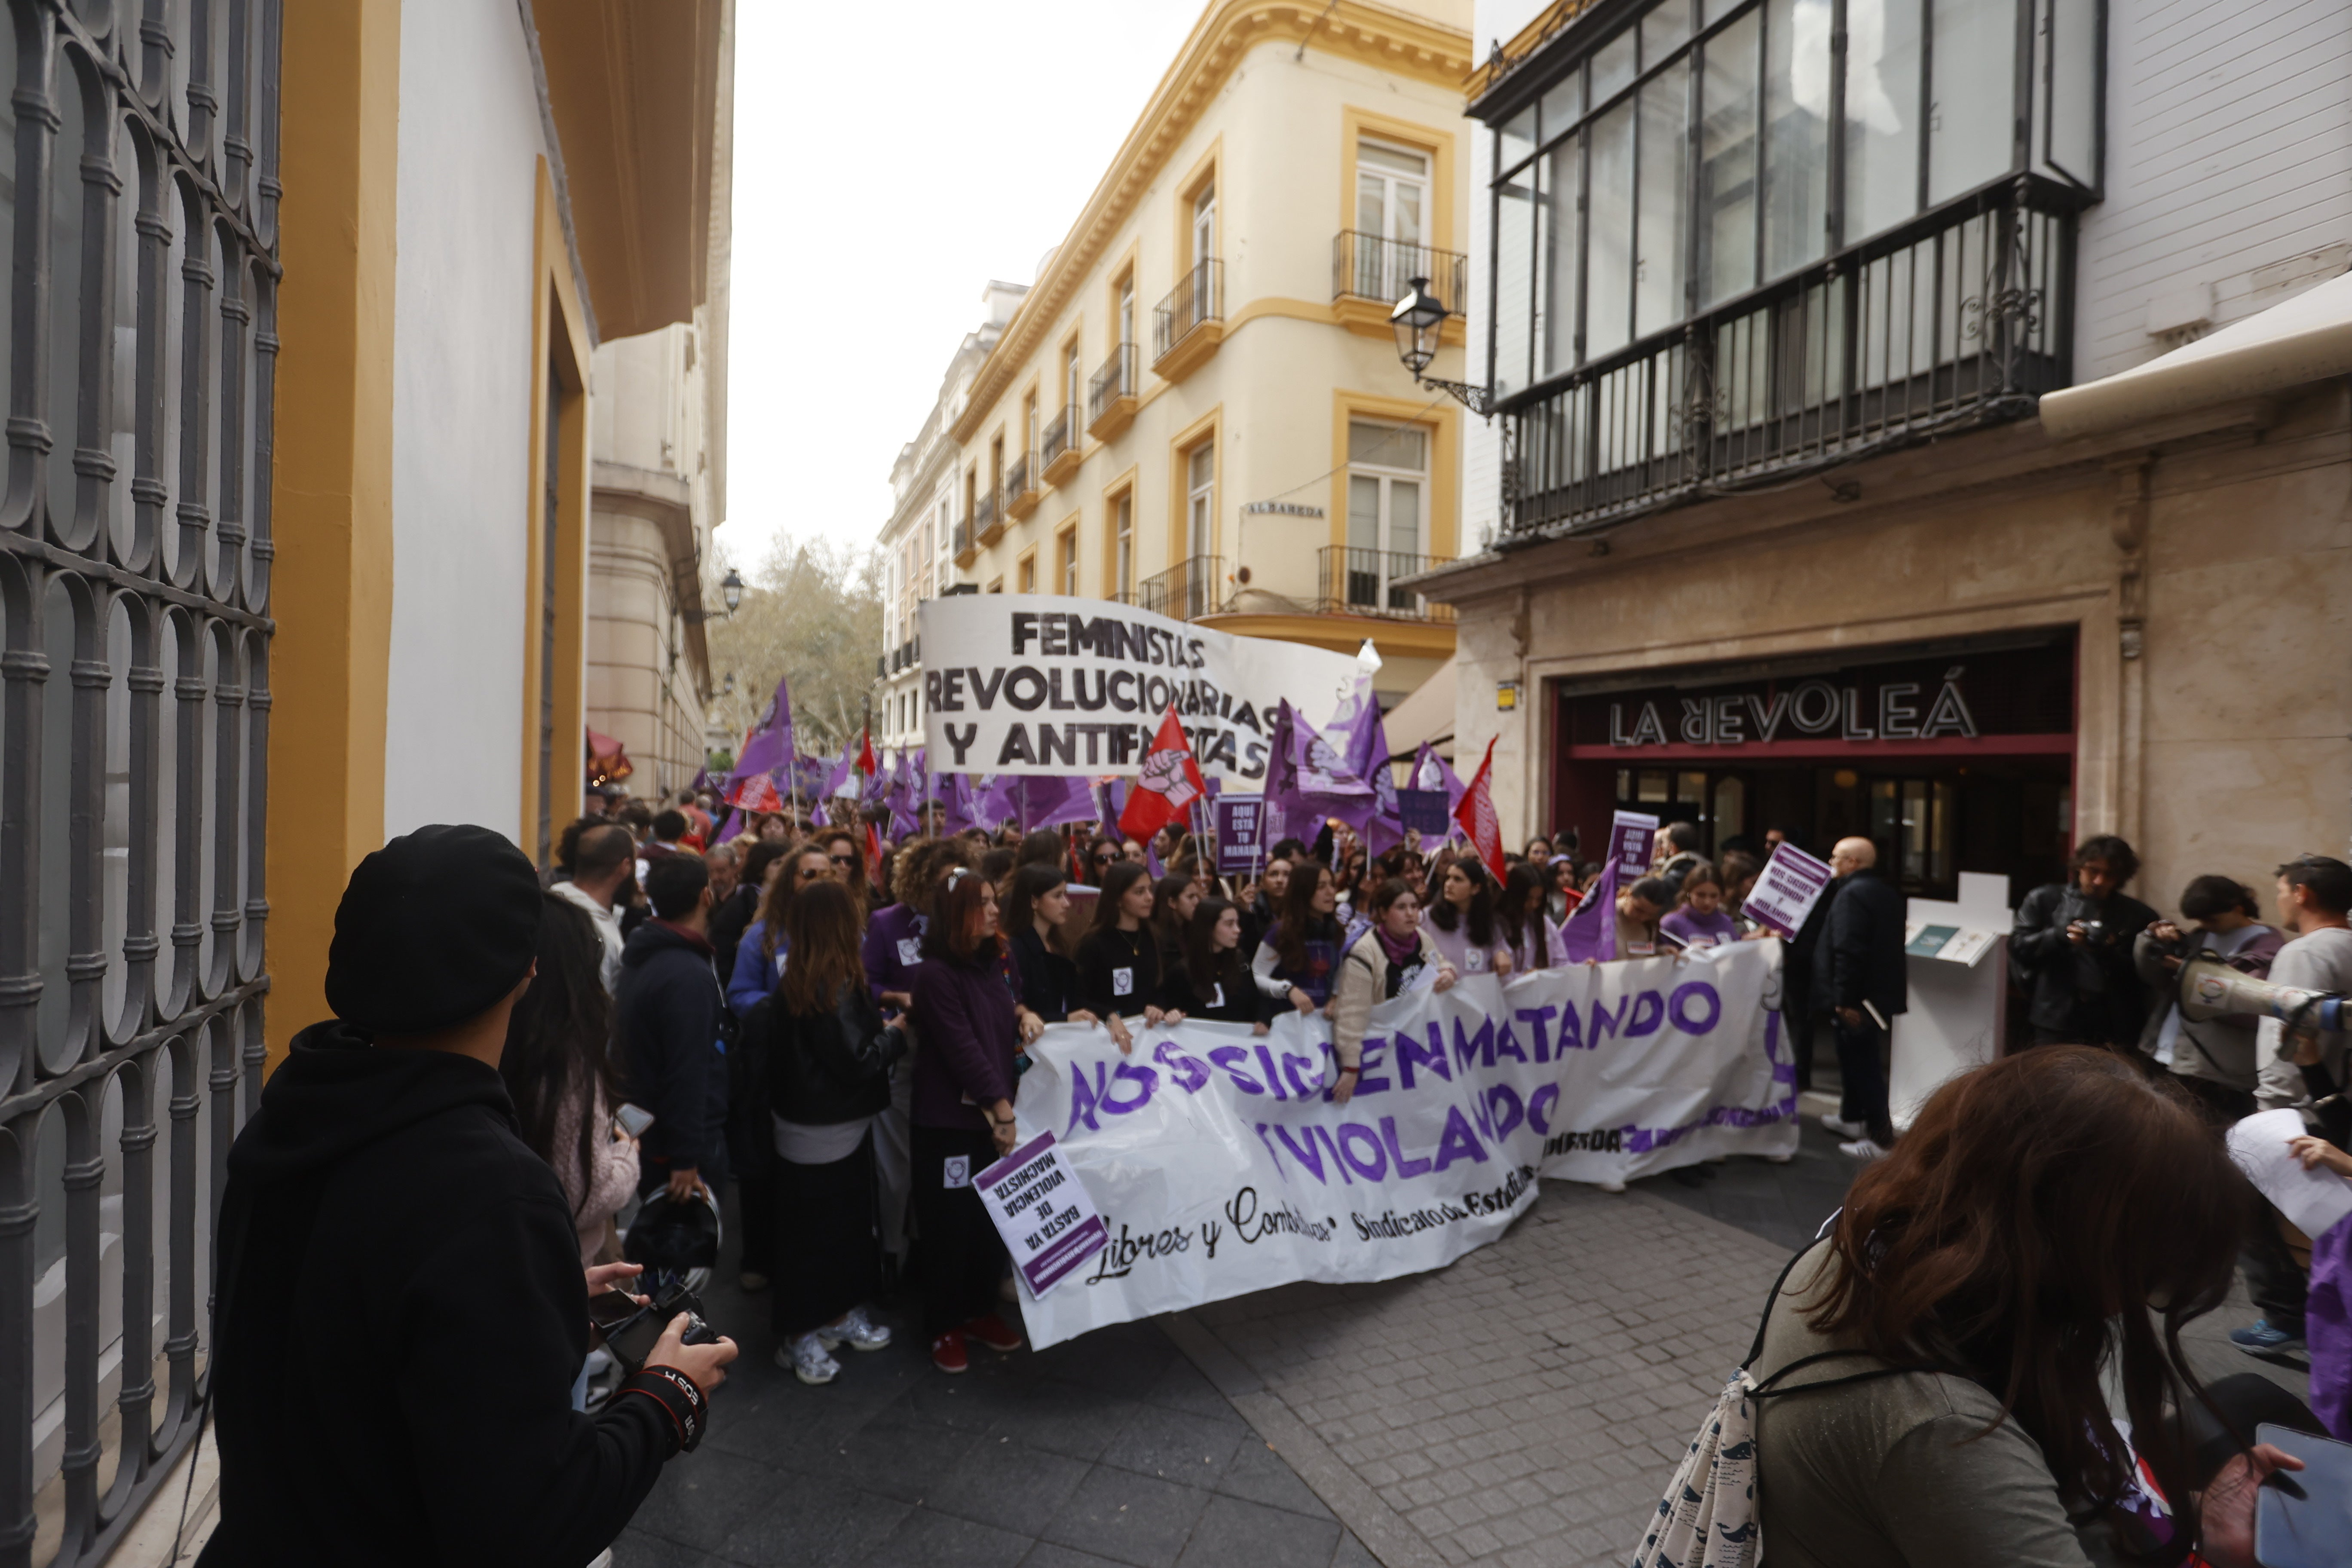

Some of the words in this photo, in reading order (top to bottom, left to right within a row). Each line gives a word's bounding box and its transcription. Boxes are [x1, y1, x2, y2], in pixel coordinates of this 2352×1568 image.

[1248, 503, 1323, 517] ALBAREDA
[1011, 612, 1204, 669] FEMINISTAS
[944, 723, 977, 765] Y
[1609, 702, 1667, 747] LA
[1237, 832, 1250, 843] TU
[1065, 1040, 1211, 1140] NOS
[1454, 980, 1721, 1075] MATANDO
[993, 1152, 1057, 1200] MACHISTA
[1003, 1169, 1066, 1219] VIOLENCIA
[1035, 1201, 1054, 1221] DE
[1041, 1205, 1081, 1239] BASTA
[1024, 1228, 1045, 1251] YA
[1085, 1216, 1193, 1285] Libres
[1201, 1221, 1221, 1260] y
[1351, 1208, 1444, 1241] Sindicato
[677, 1377, 698, 1406] EOS
